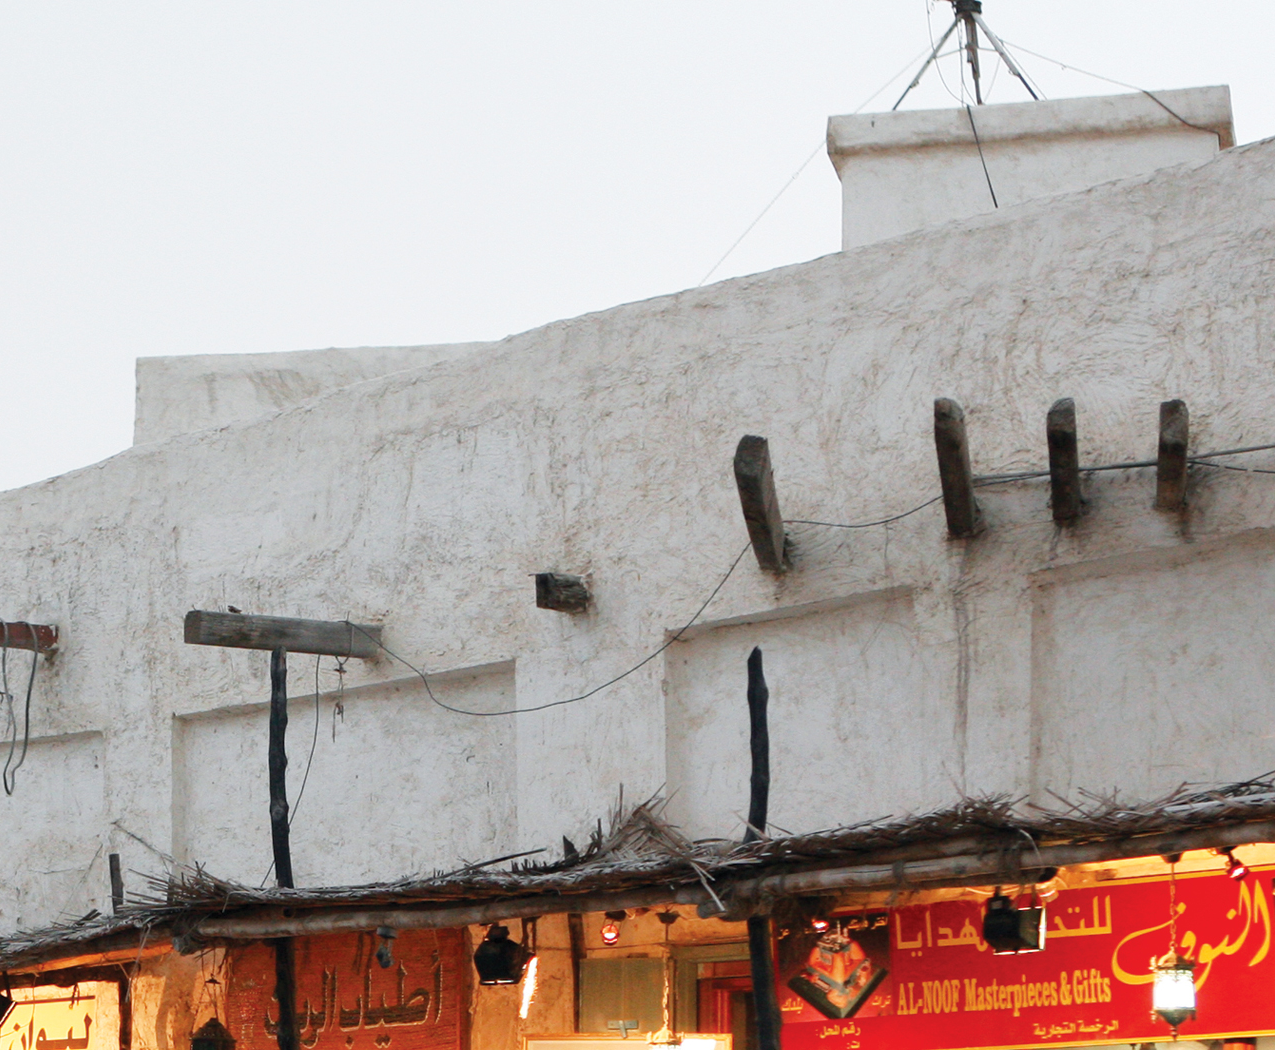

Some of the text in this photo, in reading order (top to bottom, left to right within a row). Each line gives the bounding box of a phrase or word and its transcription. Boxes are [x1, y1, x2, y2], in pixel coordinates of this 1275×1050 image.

[1045, 895, 1113, 939] للتح
[1112, 880, 1272, 991] النوف
[897, 968, 1112, 1018] AL-NOOF Masterpieces & Gifts
[1033, 1019, 1120, 1040] الرخصة التجارية
